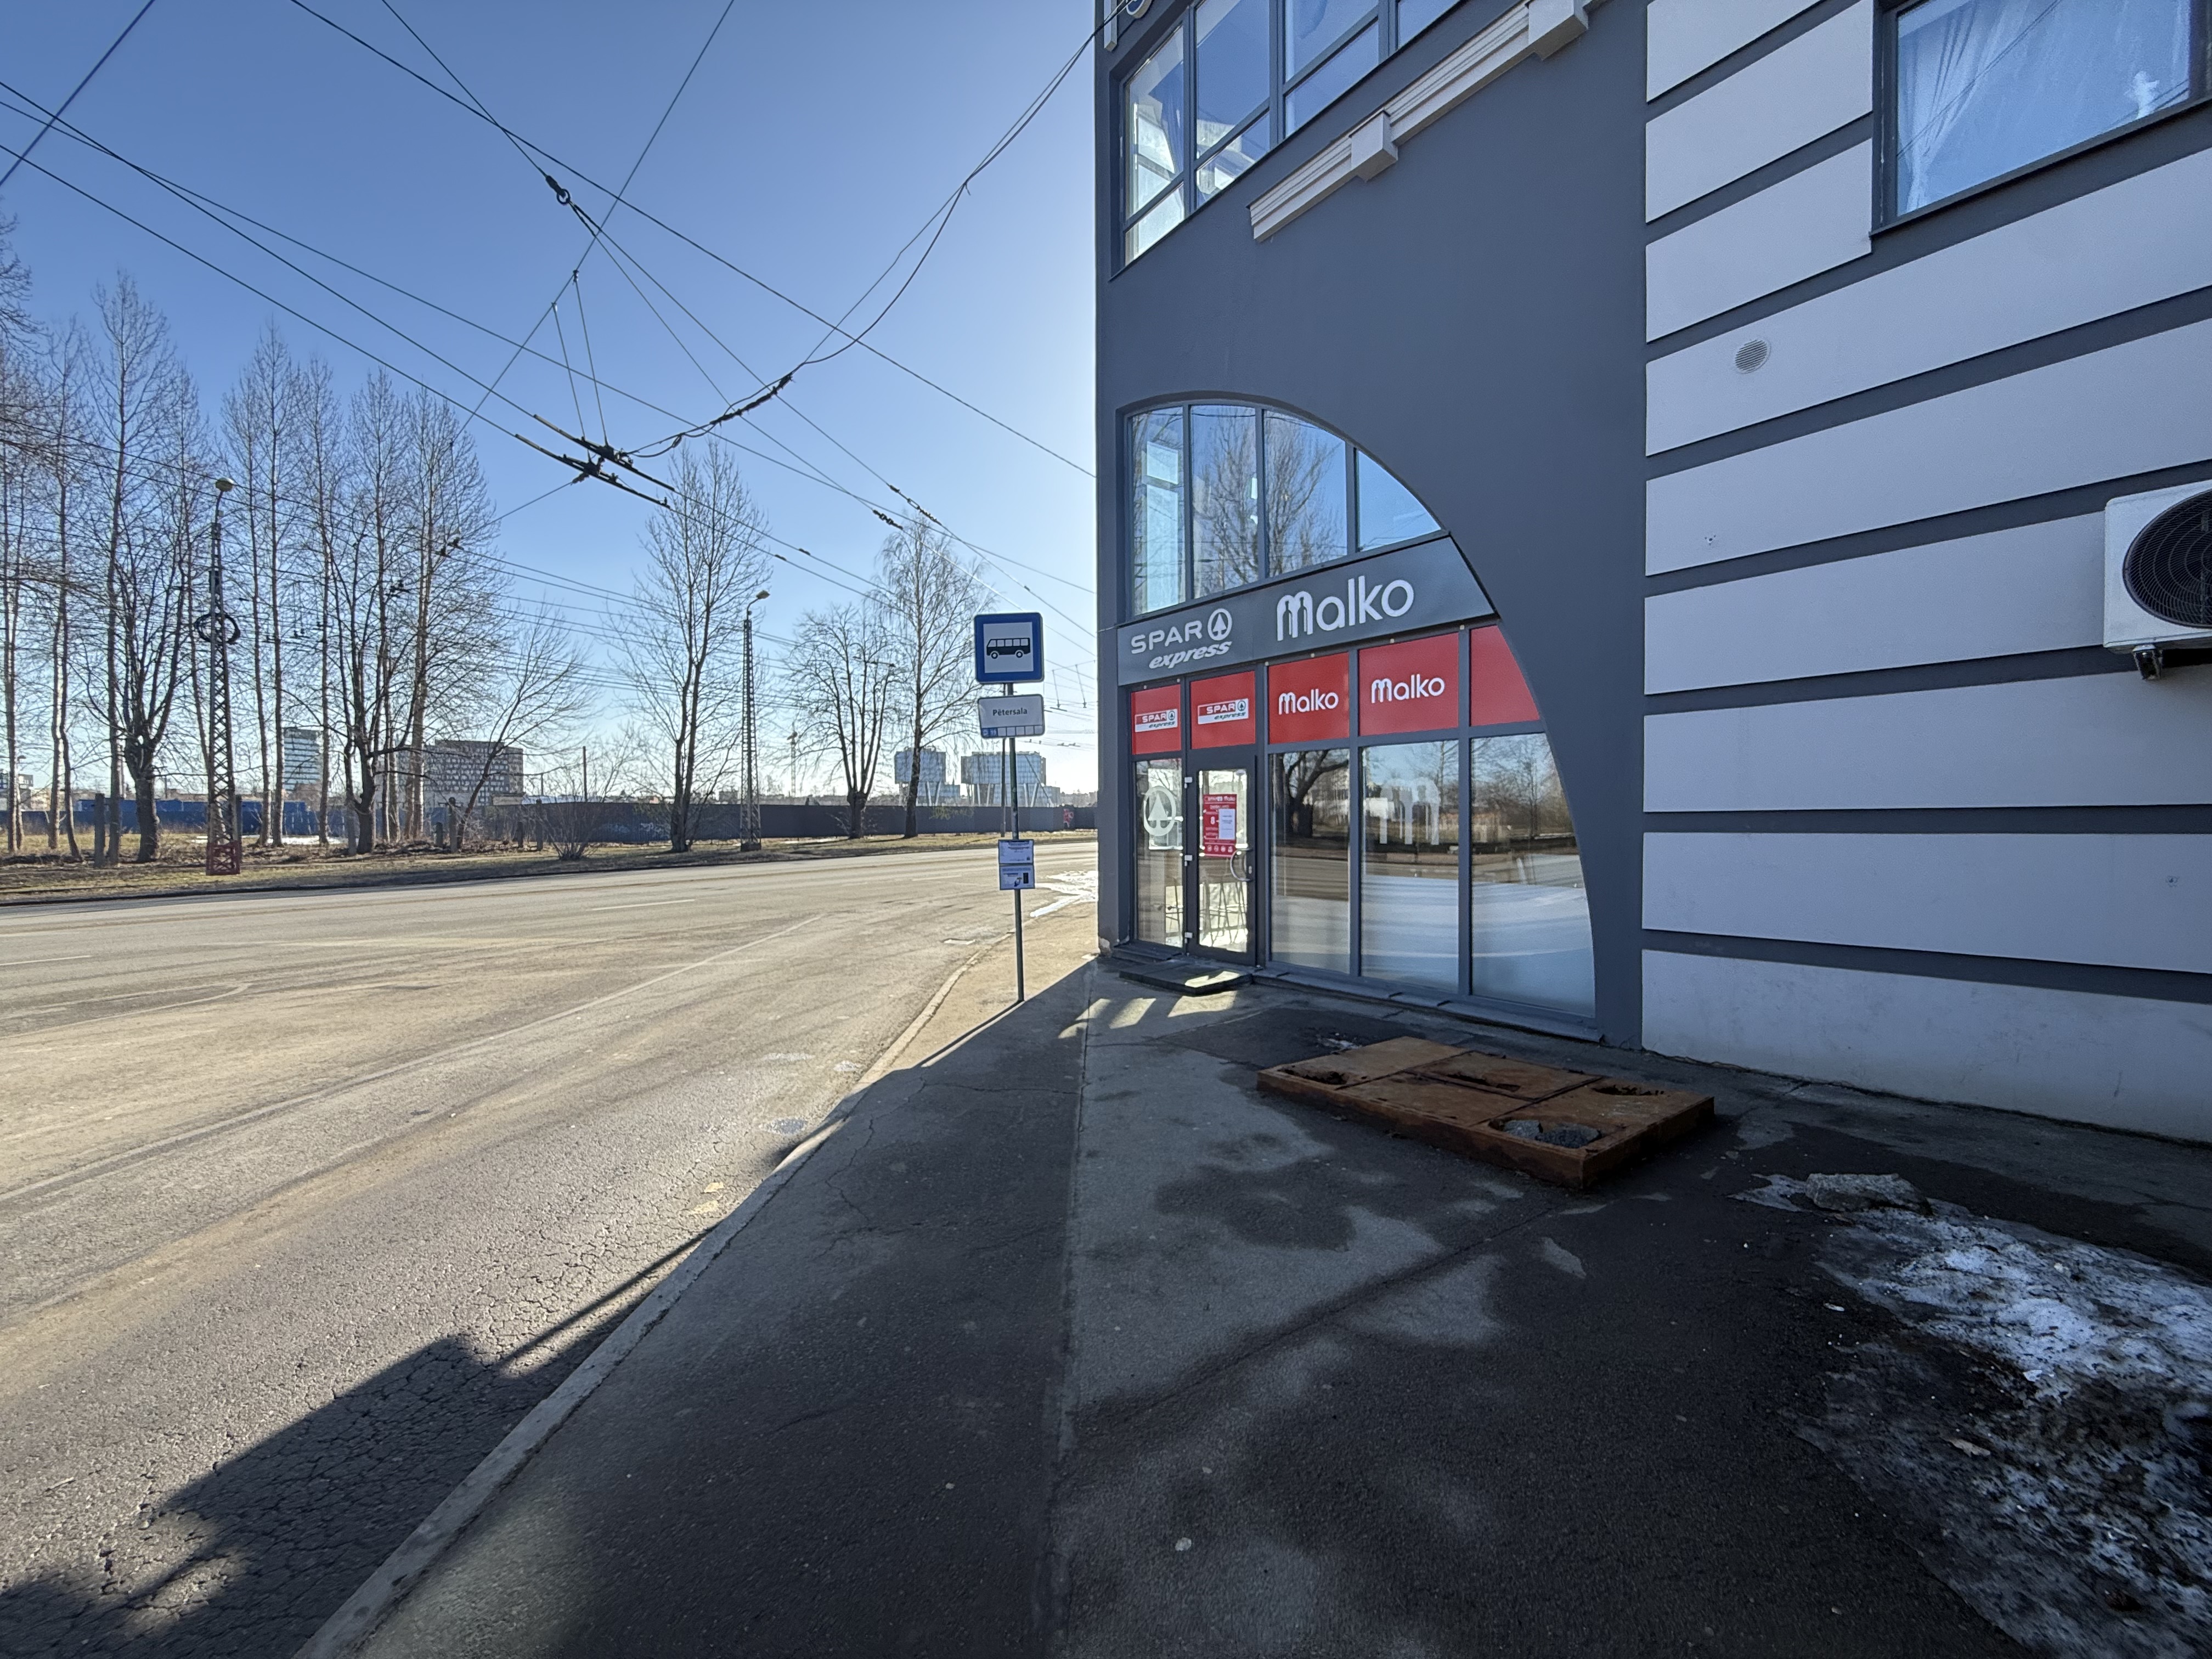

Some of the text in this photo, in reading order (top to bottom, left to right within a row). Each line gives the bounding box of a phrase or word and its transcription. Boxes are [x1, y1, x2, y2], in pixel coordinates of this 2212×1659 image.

[1131, 620, 1203, 654] SPAR
[1149, 641, 1233, 669] express
[1206, 703, 1235, 714] SPAR
[1142, 713, 1166, 723] SPAR
[1214, 712, 1246, 720] express
